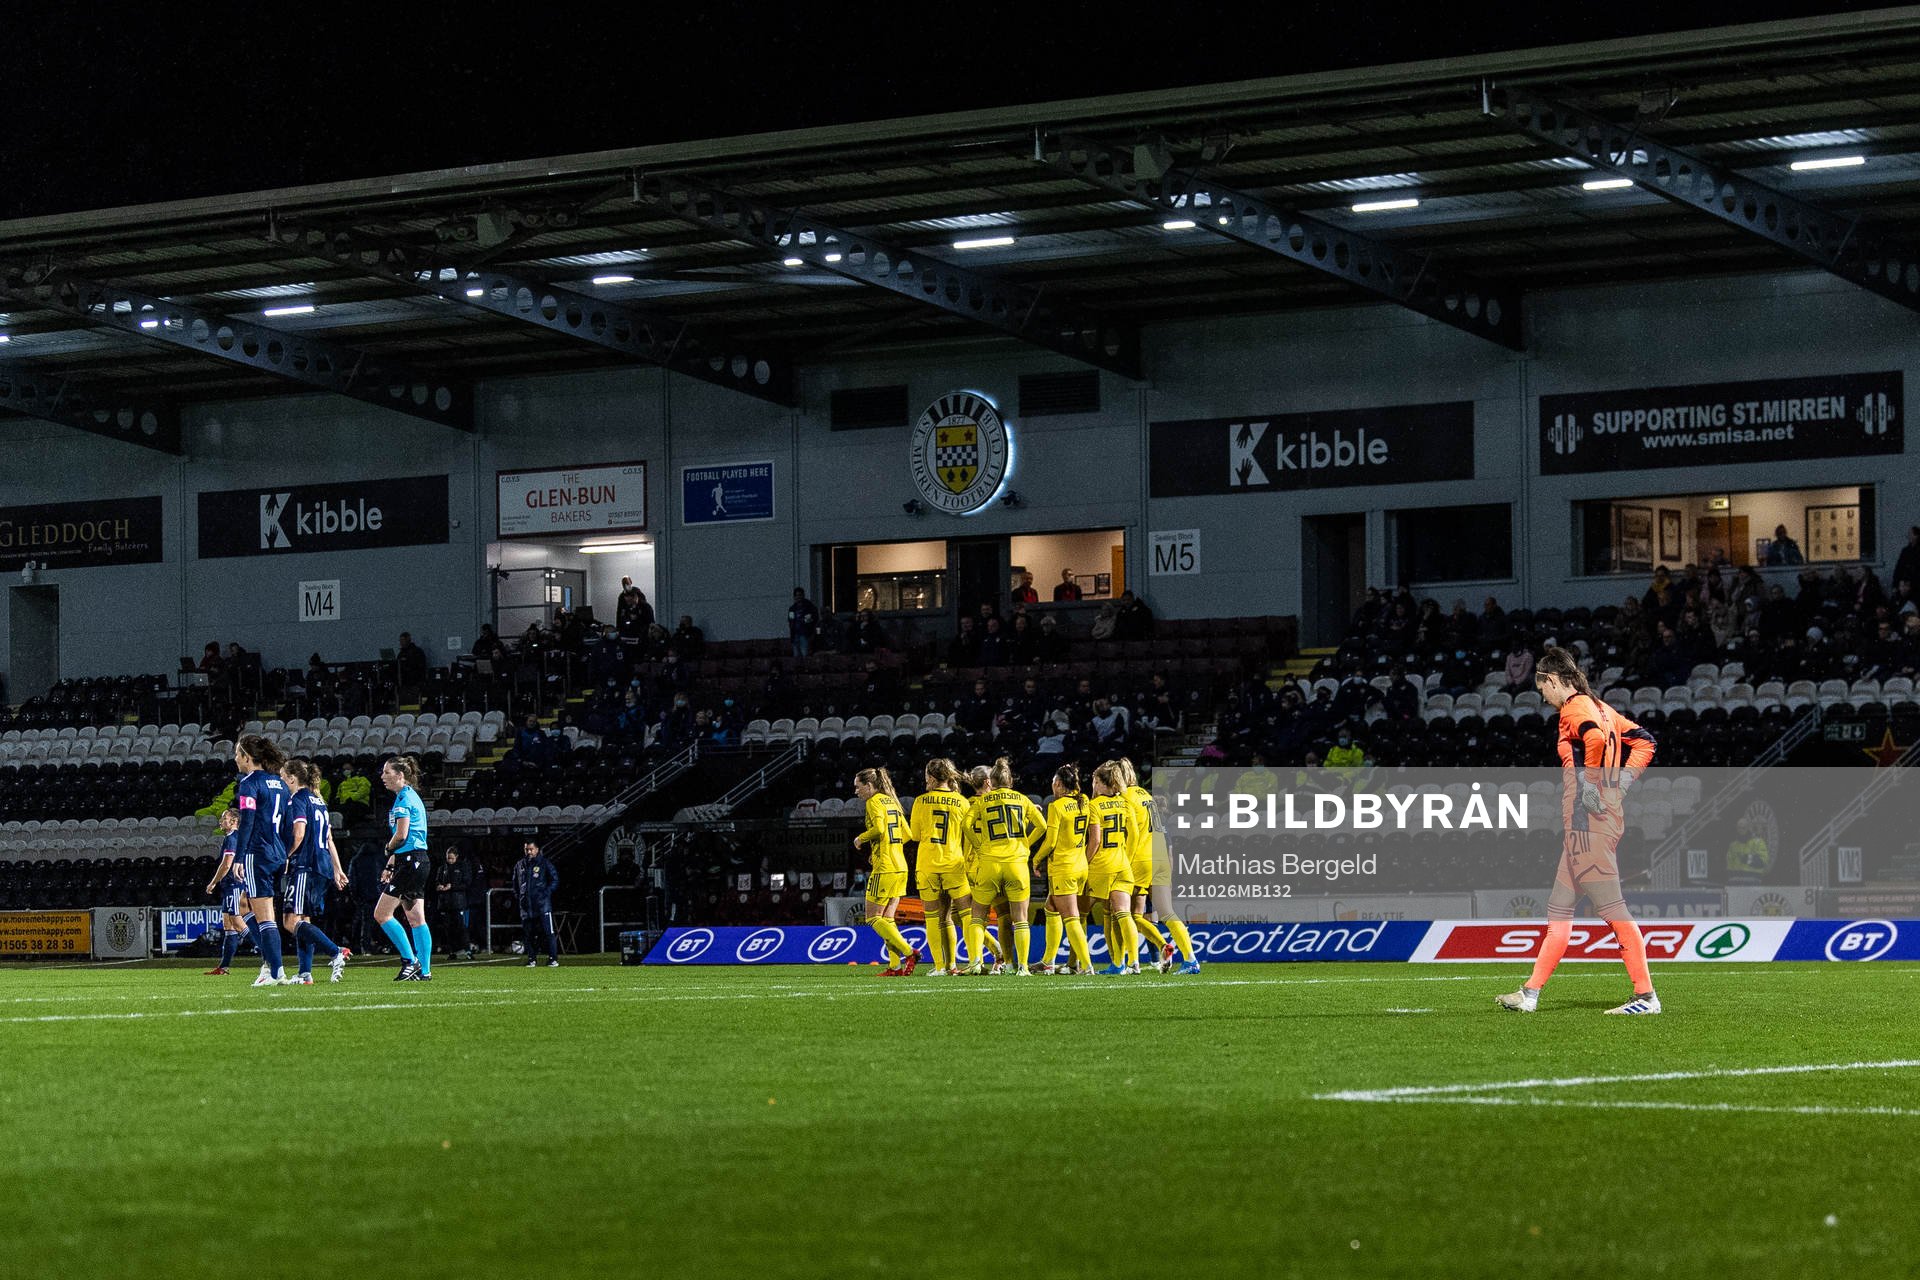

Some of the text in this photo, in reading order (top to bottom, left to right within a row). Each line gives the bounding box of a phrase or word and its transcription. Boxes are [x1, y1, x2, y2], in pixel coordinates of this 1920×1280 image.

[1592, 404, 1727, 435] SUPPORTING
[1733, 396, 1846, 428] ST.MIRREN
[1642, 423, 1794, 449] www.smisa.net
[943, 465, 1000, 508] FOOTBALL
[982, 413, 1001, 455] CLUB
[1276, 427, 1389, 471] kibble
[562, 473, 580, 484] THE
[686, 466, 769, 482] FOOTBALL PLAYED HERE
[526, 485, 615, 508] GLEN-BUN
[296, 497, 383, 536] kibble
[551, 510, 591, 523] BAKERS
[1155, 543, 1194, 573] M5
[305, 591, 334, 617] M4
[272, 793, 282, 834] 4
[986, 804, 1025, 841] 20
[930, 810, 950, 844] 3
[166, 910, 184, 926] IQA
[188, 910, 205, 925] IQA
[31, 939, 43, 950] 38
[46, 939, 58, 950] 28
[62, 939, 75, 950] 38
[675, 938, 706, 952] BT
[745, 938, 776, 952] BT
[817, 937, 848, 951] BT
[1840, 931, 1885, 951] BT
